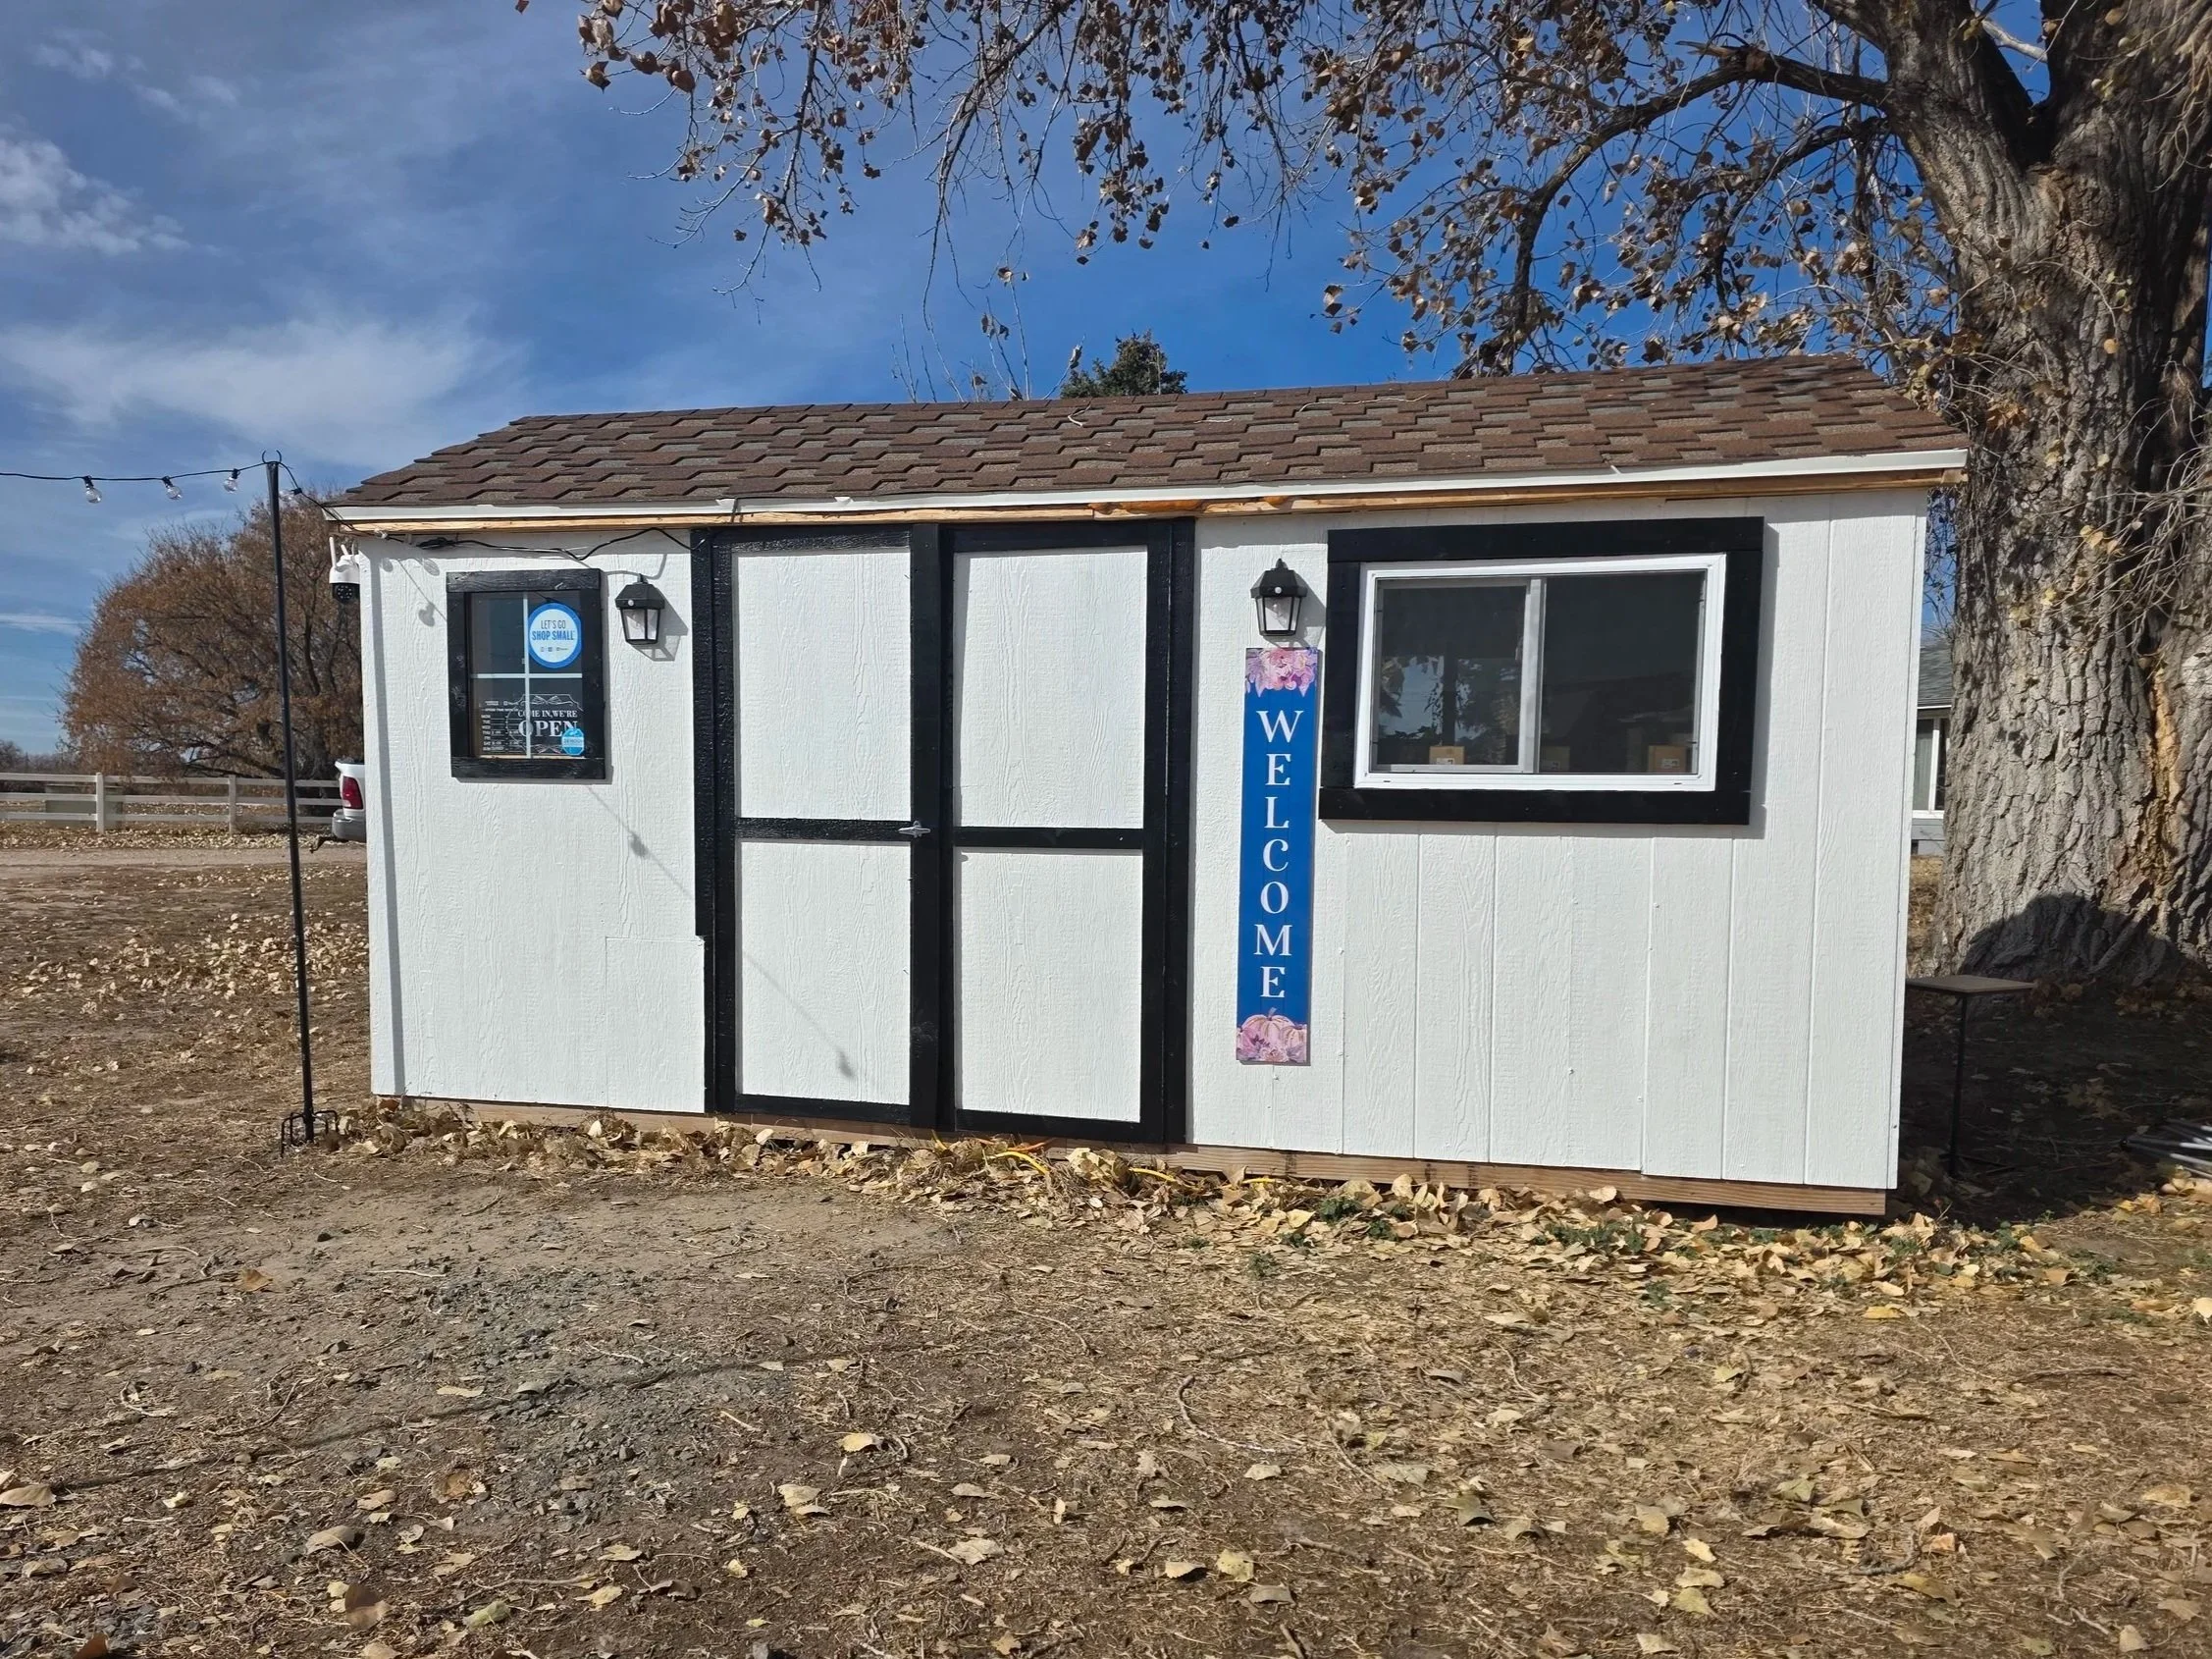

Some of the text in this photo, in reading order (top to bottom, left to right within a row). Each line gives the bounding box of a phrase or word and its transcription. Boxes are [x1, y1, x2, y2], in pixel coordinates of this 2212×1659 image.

[541, 619, 566, 629] LET'S GO
[532, 630, 574, 640] SHOP SMALL
[518, 720, 578, 737] OPEN
[1253, 710, 1304, 998] WELCOME
